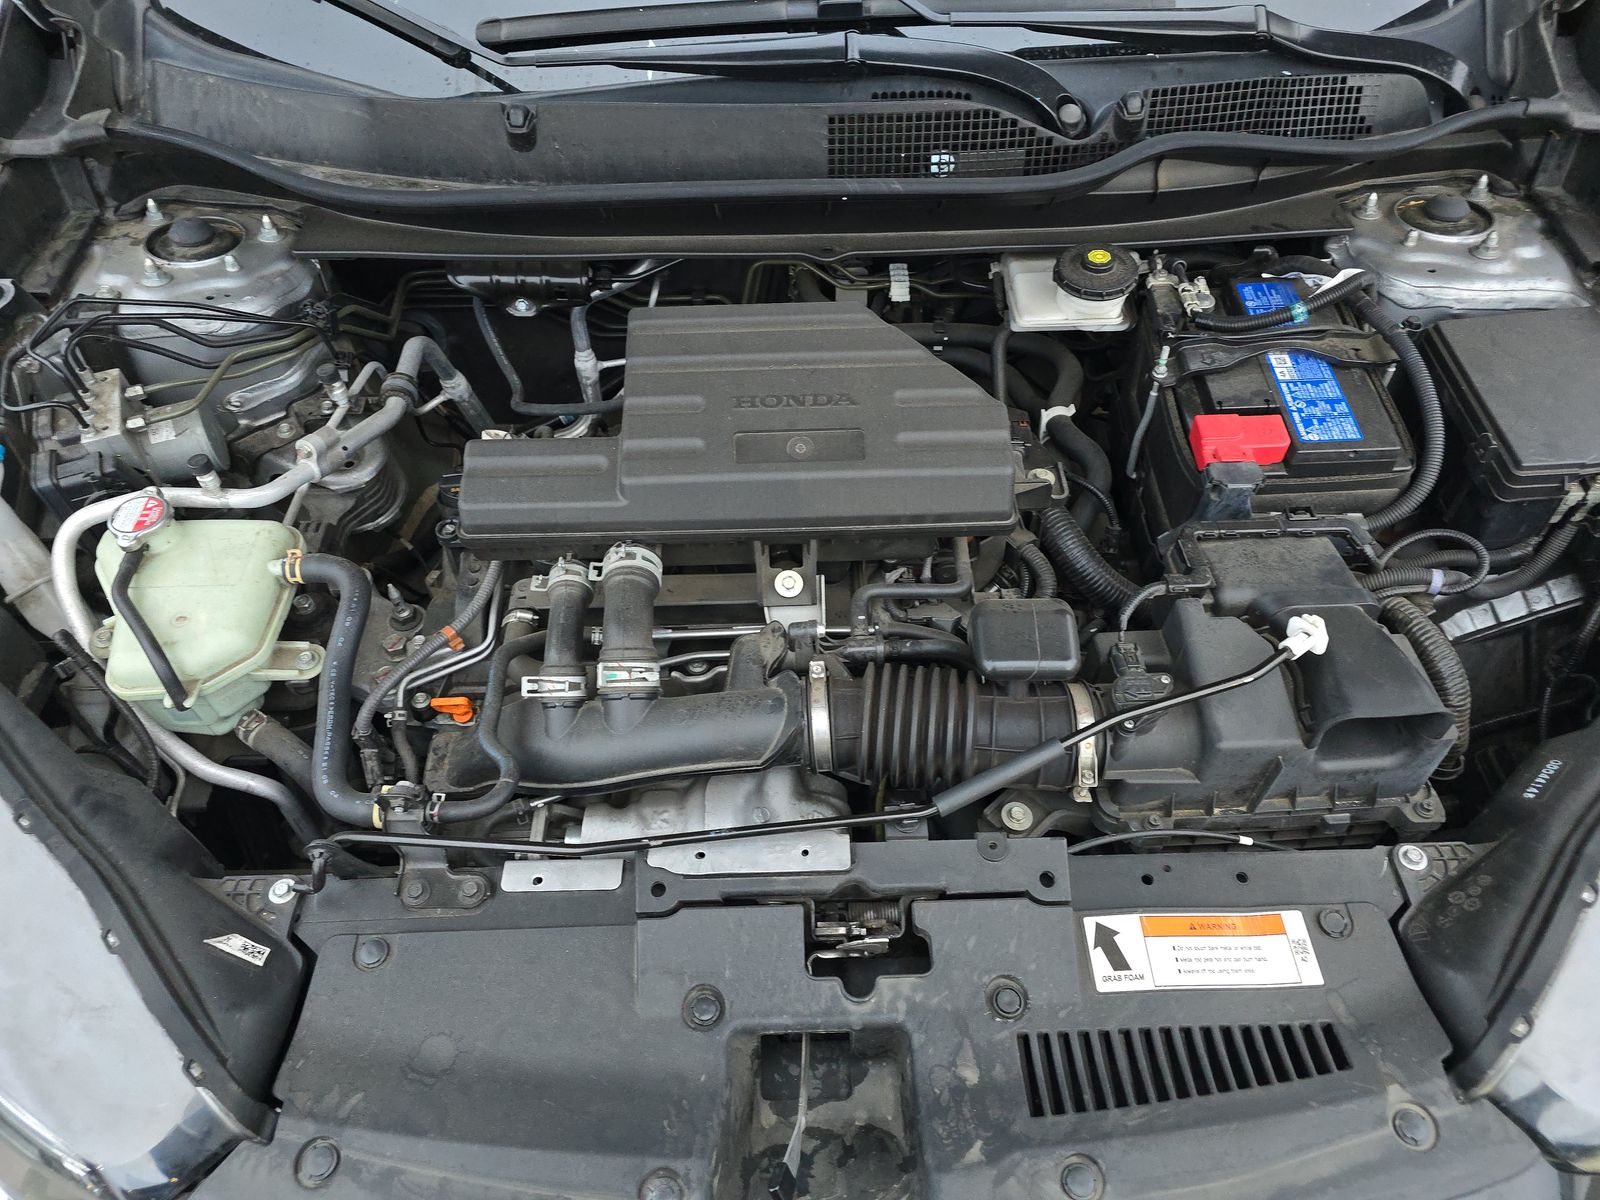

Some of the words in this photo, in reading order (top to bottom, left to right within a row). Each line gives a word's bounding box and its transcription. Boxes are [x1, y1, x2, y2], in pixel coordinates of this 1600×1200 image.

[730, 393, 861, 410] HONDA
[1197, 923, 1237, 931] WARNING
[1102, 975, 1122, 983] GRAB
[1124, 973, 1145, 981] FOAM
